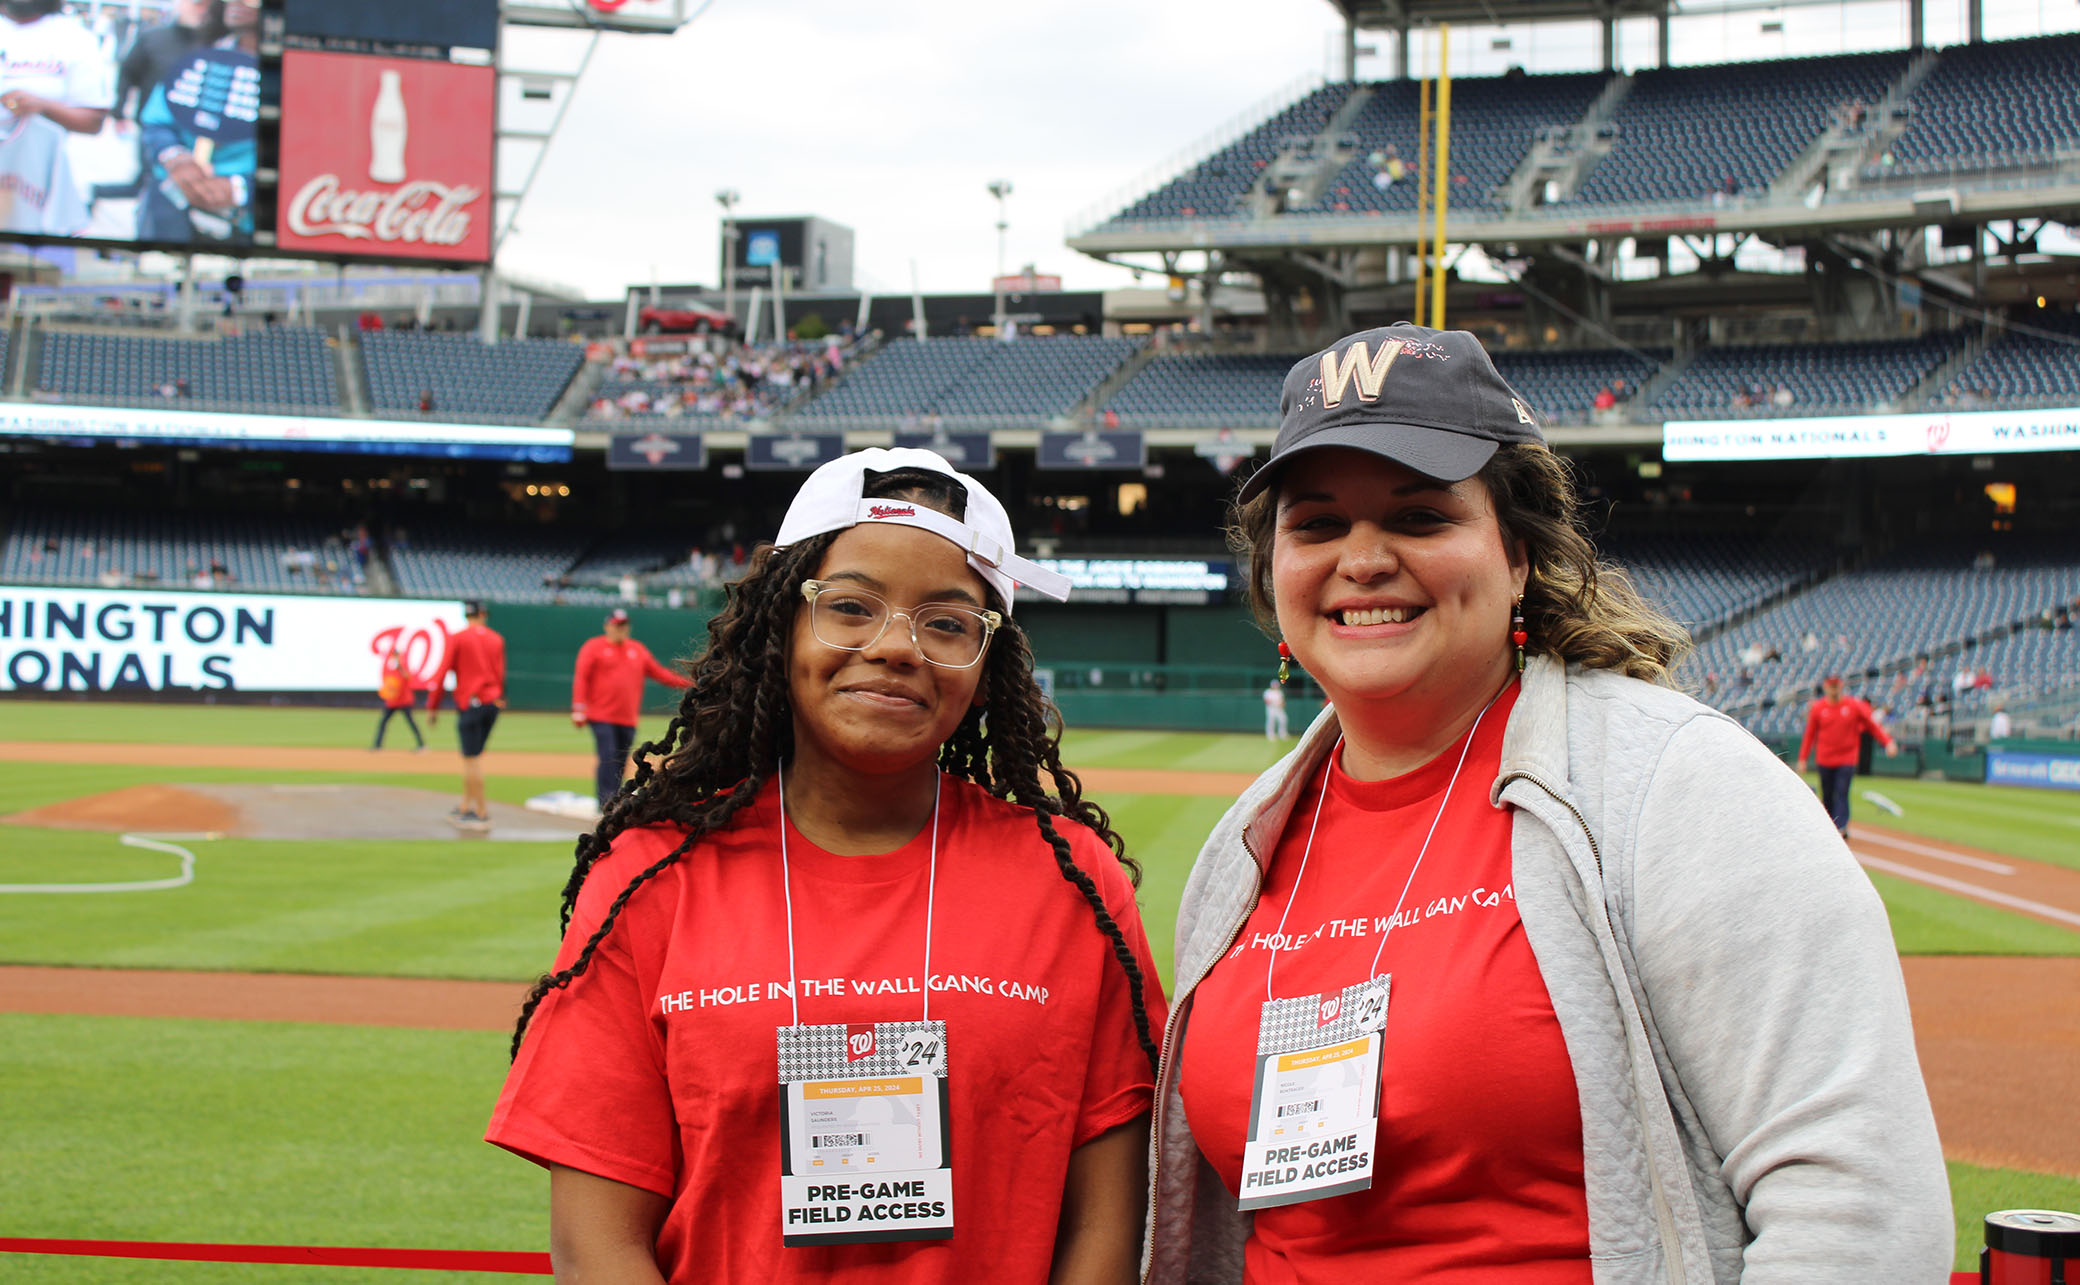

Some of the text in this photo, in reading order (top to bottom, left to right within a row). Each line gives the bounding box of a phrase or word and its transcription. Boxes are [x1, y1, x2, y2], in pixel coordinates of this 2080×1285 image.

[287, 173, 483, 245] Coca-Cola
[1320, 337, 1405, 409] W
[1771, 429, 1887, 445] NATIONALS
[1993, 424, 2080, 440] WASHIN
[1250, 932, 1308, 952] HOLE
[1329, 917, 1368, 938] THE
[1374, 906, 1420, 934] WALL
[660, 974, 1050, 1015] THE HOLE IN THE WALL GANG CAMP
[819, 1084, 900, 1095] THURSDAY, APR 25, 2024
[1265, 1134, 1358, 1166] PRE-GAME
[1246, 1152, 1369, 1189] FIELD ACCESS
[807, 1181, 926, 1202] PRE-GAME
[788, 1201, 946, 1225] FIELD ACCESS
